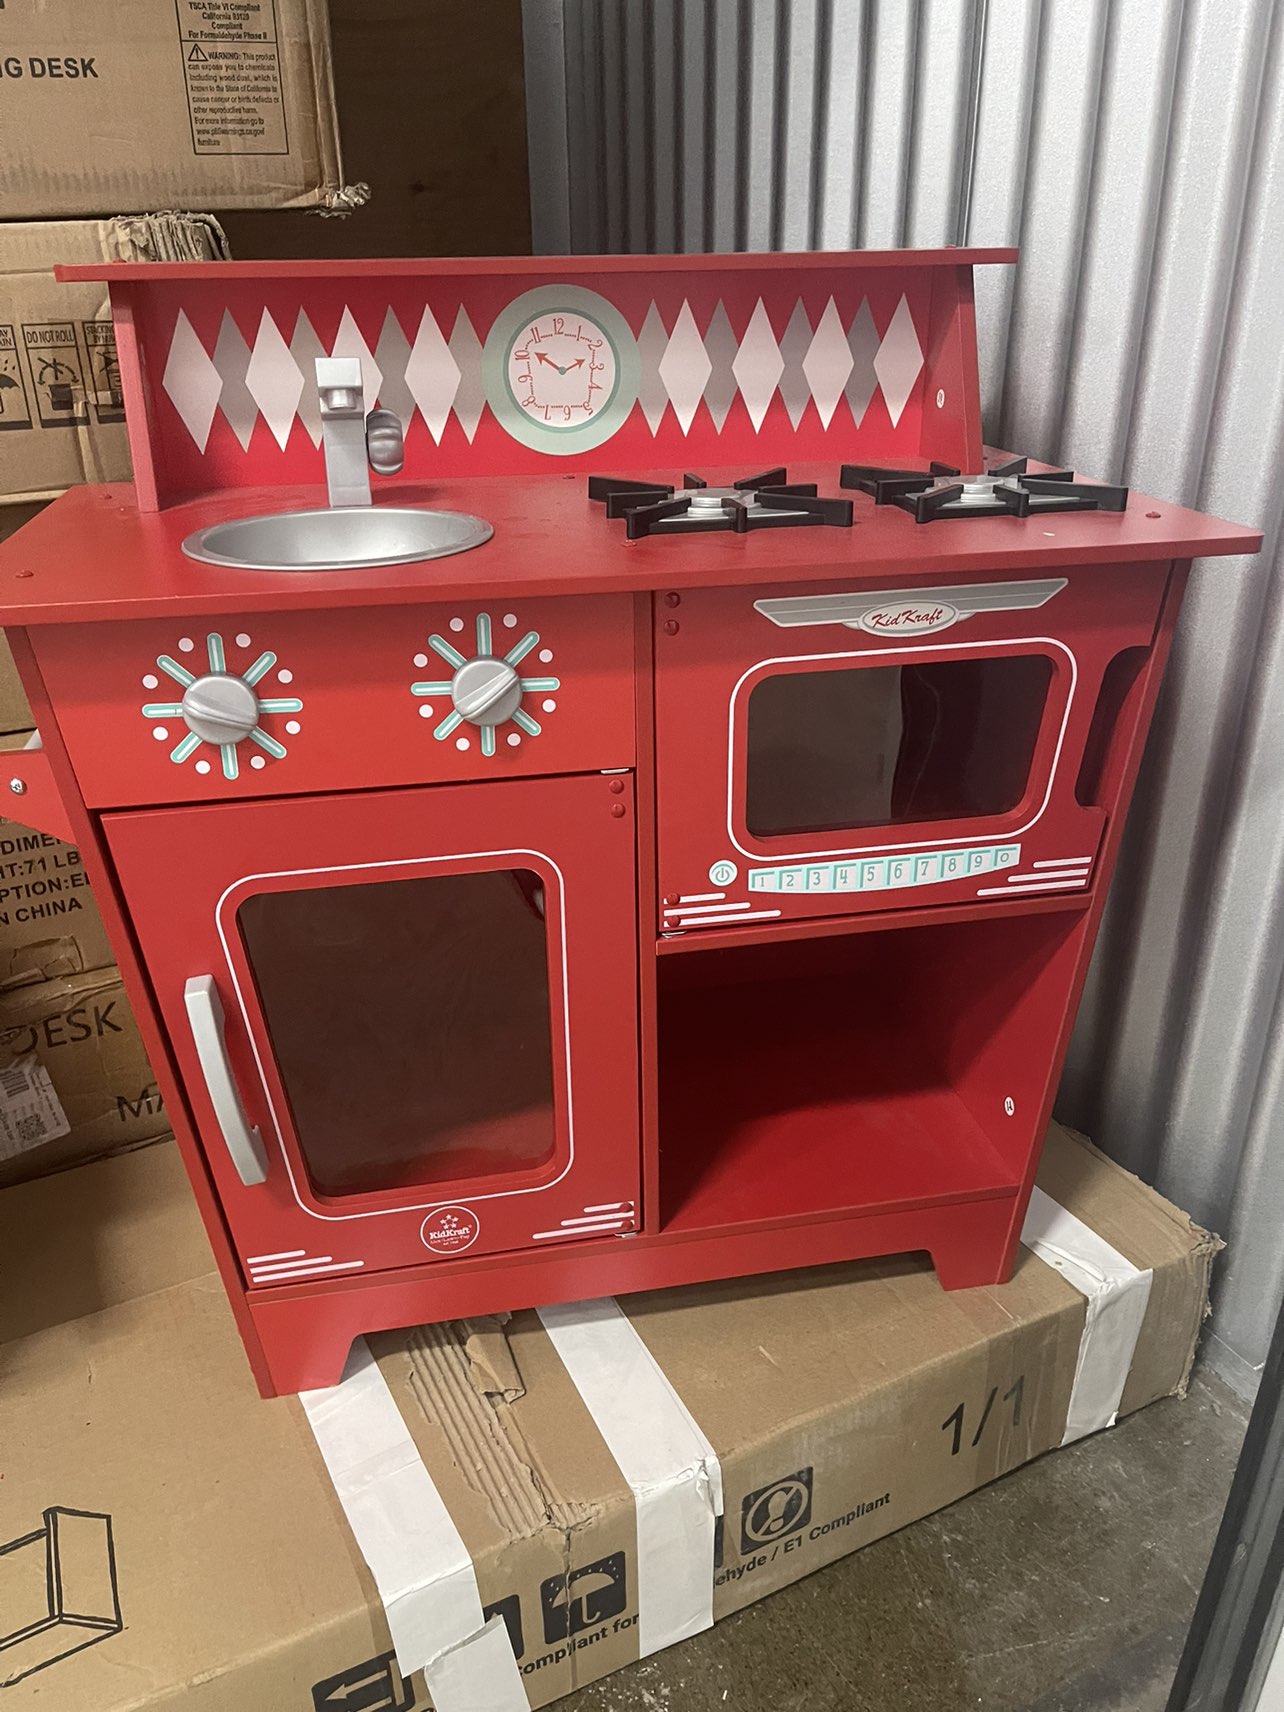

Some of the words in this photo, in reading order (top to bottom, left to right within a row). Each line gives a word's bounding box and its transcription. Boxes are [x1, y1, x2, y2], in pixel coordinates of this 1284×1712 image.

[211, 22, 243, 30] Compliant
[28, 57, 98, 78] DESK
[530, 326, 542, 344] 11
[552, 318, 565, 336] 12
[576, 325, 582, 342] 1
[26, 331, 38, 344] DO
[40, 330, 56, 342] NOT
[55, 329, 74, 342] ROLL
[588, 340, 603, 350] 2
[514, 350, 530, 361] 10
[589, 362, 605, 371] 3
[518, 374, 533, 384] 9
[588, 382, 604, 390] 4
[522, 396, 536, 407] 8
[582, 402, 594, 416] 5
[544, 404, 552, 420] 7
[563, 405, 572, 421] 6
[872, 608, 943, 628] KidKraft
[1, 833, 60, 855] DIME
[760, 877, 764, 887] 1
[786, 874, 794, 886] 2
[813, 872, 820, 886] 3
[840, 869, 848, 884] 4
[867, 866, 875, 882] 5
[894, 863, 902, 879] 6
[921, 861, 929, 876] 7
[948, 858, 956, 872] 8
[974, 855, 982, 868] 9
[16, 897, 83, 922] CHINA
[942, 1375, 1024, 1456] 1/1
[714, 1556, 767, 1589] ehyde
[784, 1535, 802, 1554] E1
[809, 1492, 890, 1540] Compliant
